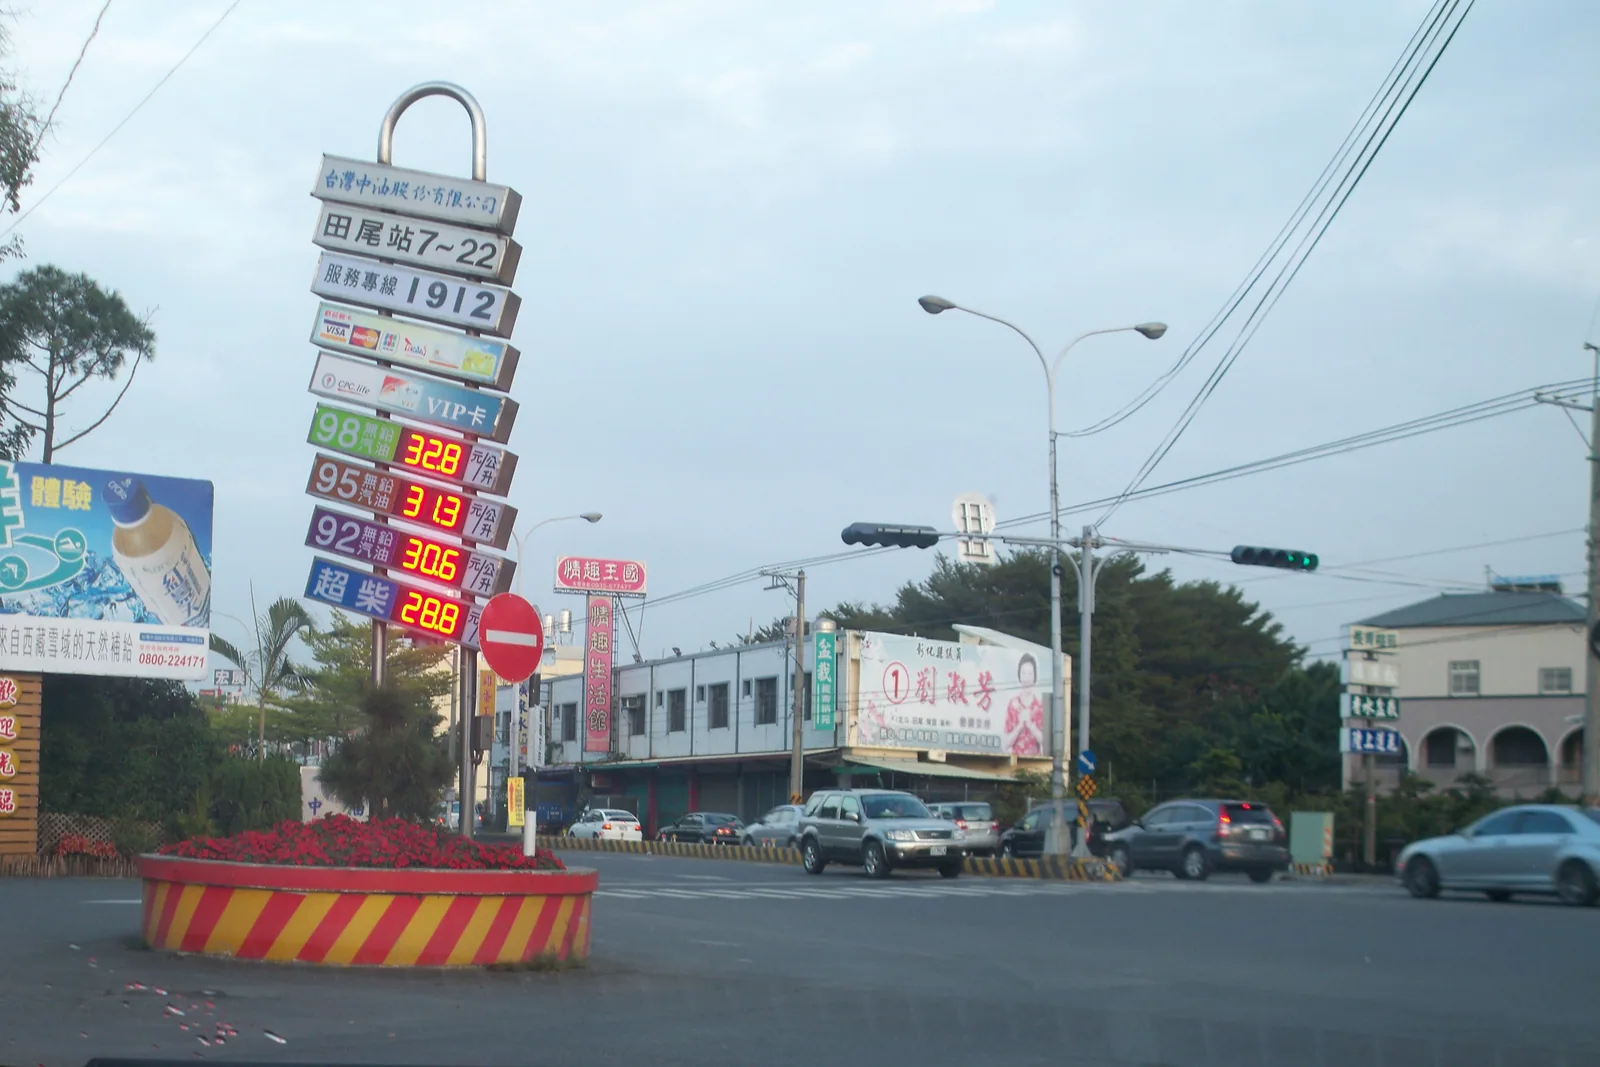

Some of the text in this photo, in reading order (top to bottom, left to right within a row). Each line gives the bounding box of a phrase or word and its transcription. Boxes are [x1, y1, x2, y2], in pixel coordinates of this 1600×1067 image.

[325, 169, 497, 214] 台灣中油股份有限公司
[324, 263, 496, 321] 服務專線 1912
[326, 325, 346, 337] VISA
[316, 412, 361, 448] 98
[427, 397, 487, 426] VIP卡
[404, 433, 462, 475] 32.8
[31, 475, 92, 511] 體驗
[315, 462, 361, 499] 95
[403, 485, 461, 527] 31.3
[315, 515, 361, 553] 92
[402, 538, 460, 581] 30.6
[564, 559, 639, 584] 情趣王國
[313, 567, 391, 615] 超柴
[401, 591, 460, 635] 28.8
[139, 653, 205, 668] 0800-224171
[588, 605, 610, 731] 情趣生活館
[892, 666, 996, 712] 1 劉淑芳
